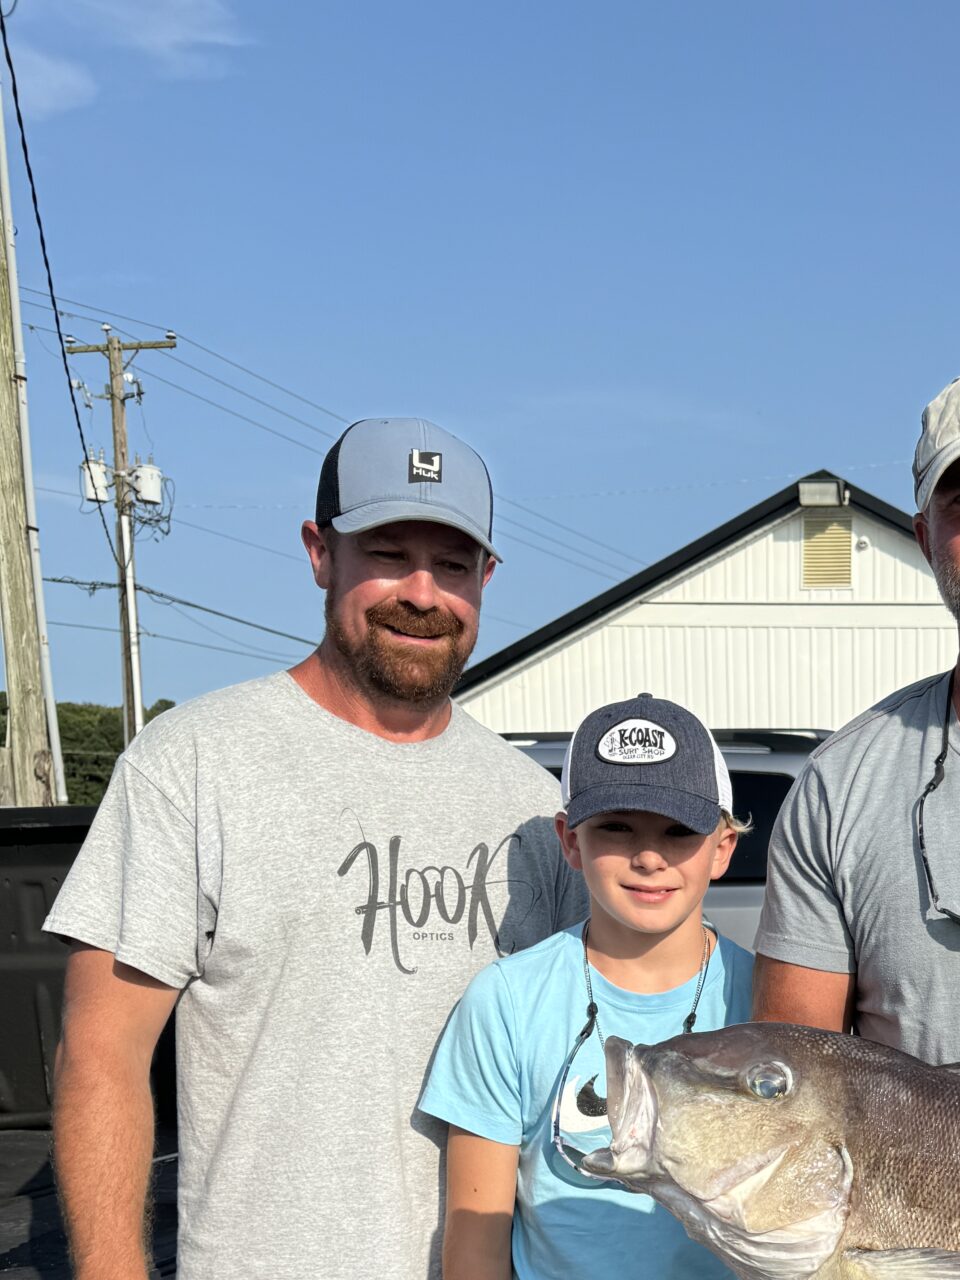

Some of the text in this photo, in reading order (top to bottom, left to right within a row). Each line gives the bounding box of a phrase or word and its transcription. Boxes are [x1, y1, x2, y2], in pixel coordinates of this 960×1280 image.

[618, 727, 665, 750] K-COAST
[618, 748, 665, 756] SURF SHOP
[412, 932, 454, 941] OPTICS
